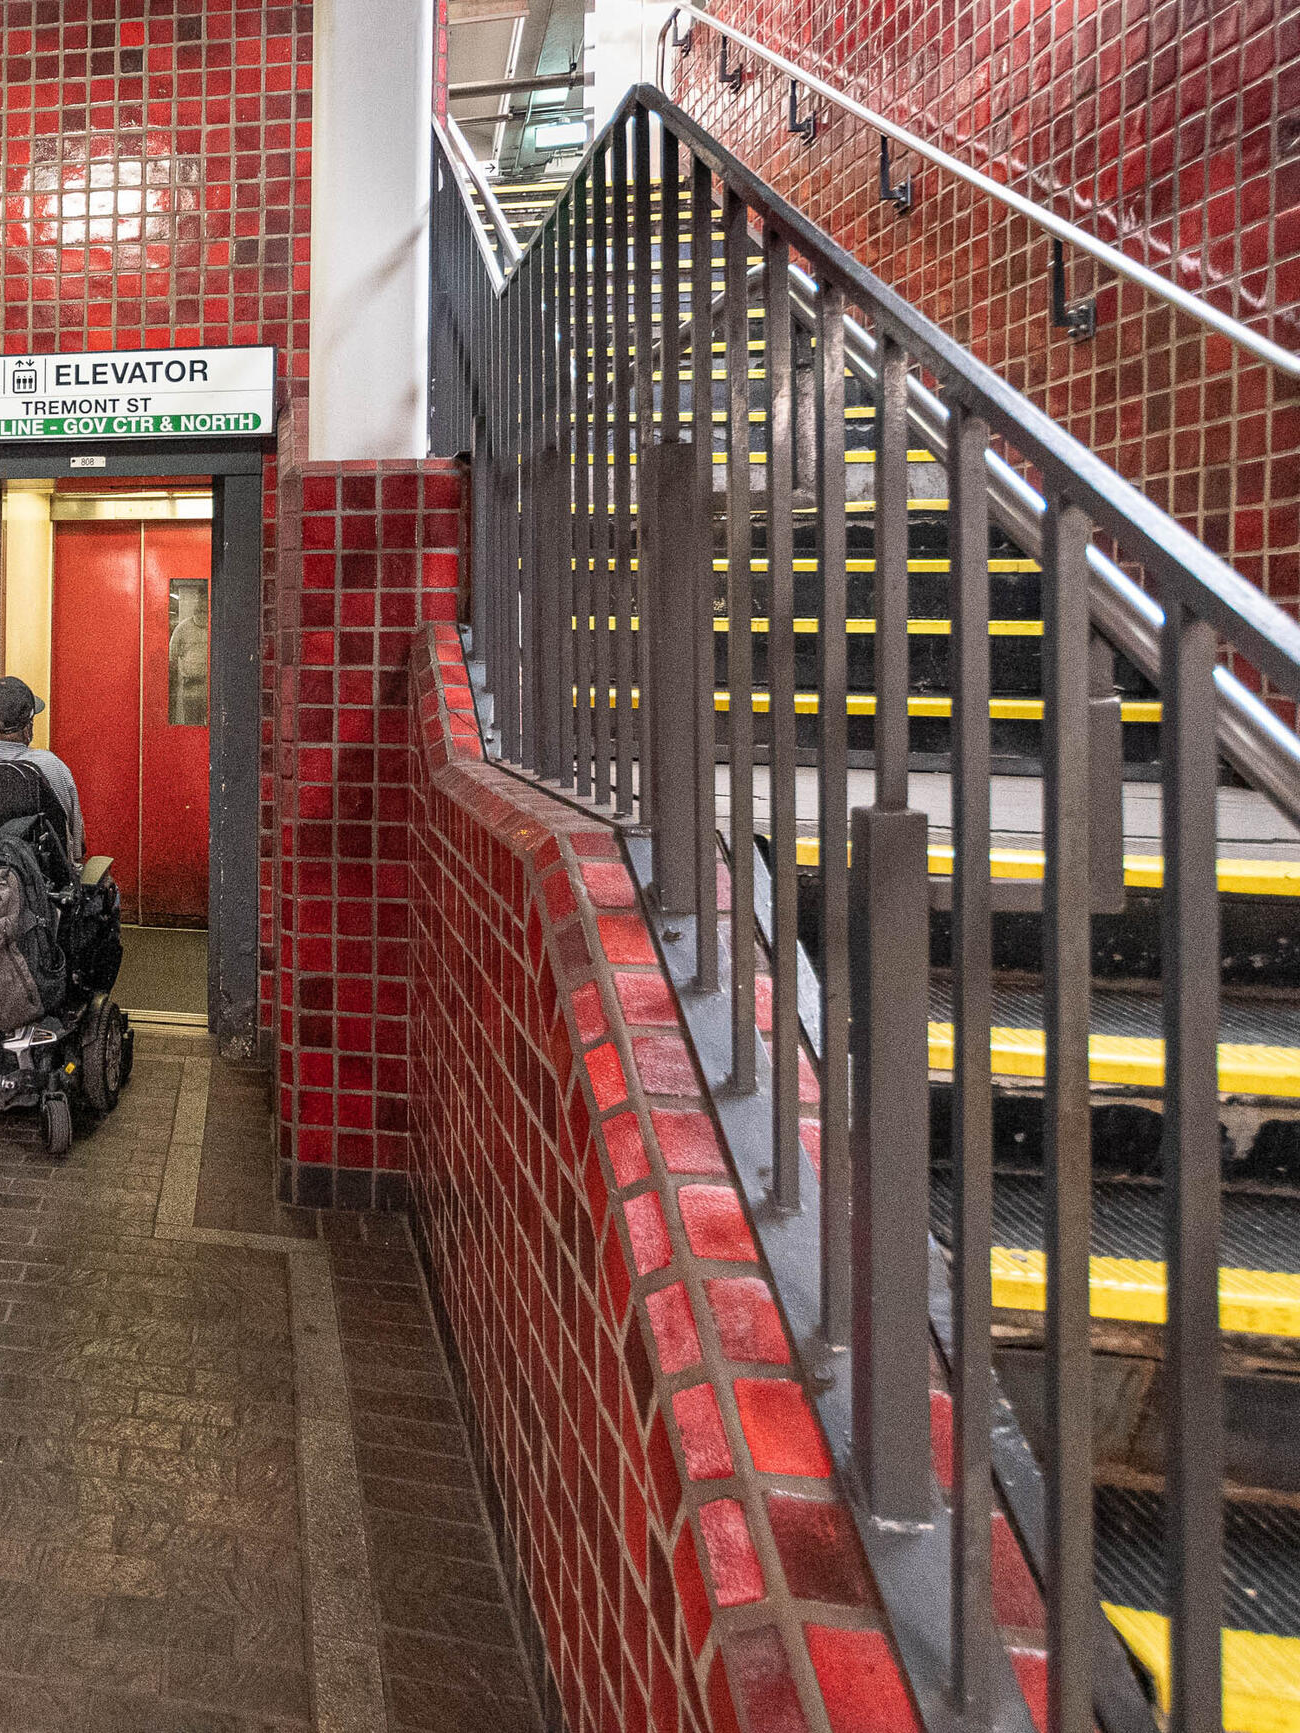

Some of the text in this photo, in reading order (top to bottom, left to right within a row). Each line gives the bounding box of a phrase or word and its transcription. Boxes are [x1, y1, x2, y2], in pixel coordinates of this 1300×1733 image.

[55, 360, 208, 386] ELEVATOR
[22, 398, 151, 415] TREMONT ST
[1, 420, 44, 435] LINE
[63, 416, 107, 434] GOV
[113, 417, 154, 432] CTR
[160, 416, 173, 431] &
[181, 414, 253, 431] NORTH
